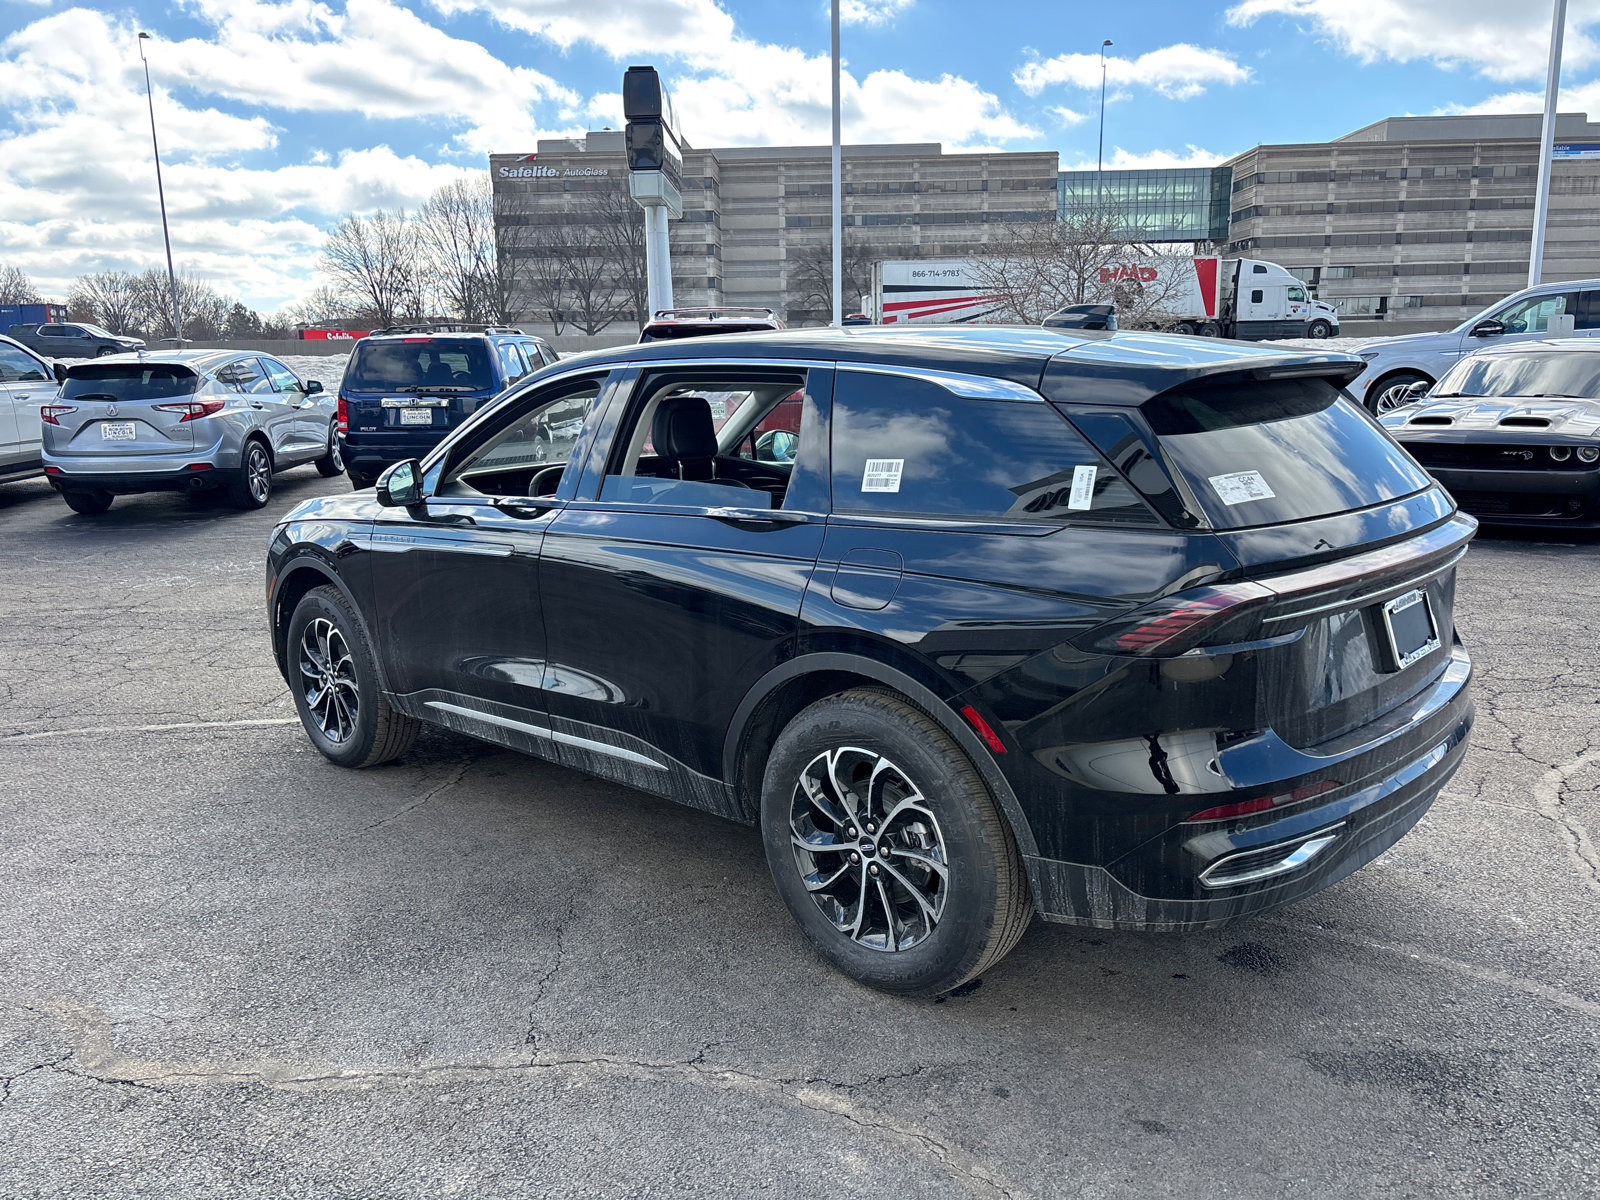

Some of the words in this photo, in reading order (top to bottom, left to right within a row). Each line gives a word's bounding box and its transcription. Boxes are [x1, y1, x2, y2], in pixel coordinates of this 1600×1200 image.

[499, 165, 557, 178] Safelite
[563, 168, 608, 177] AutoGlass
[911, 269, 960, 278] 866-714-9783
